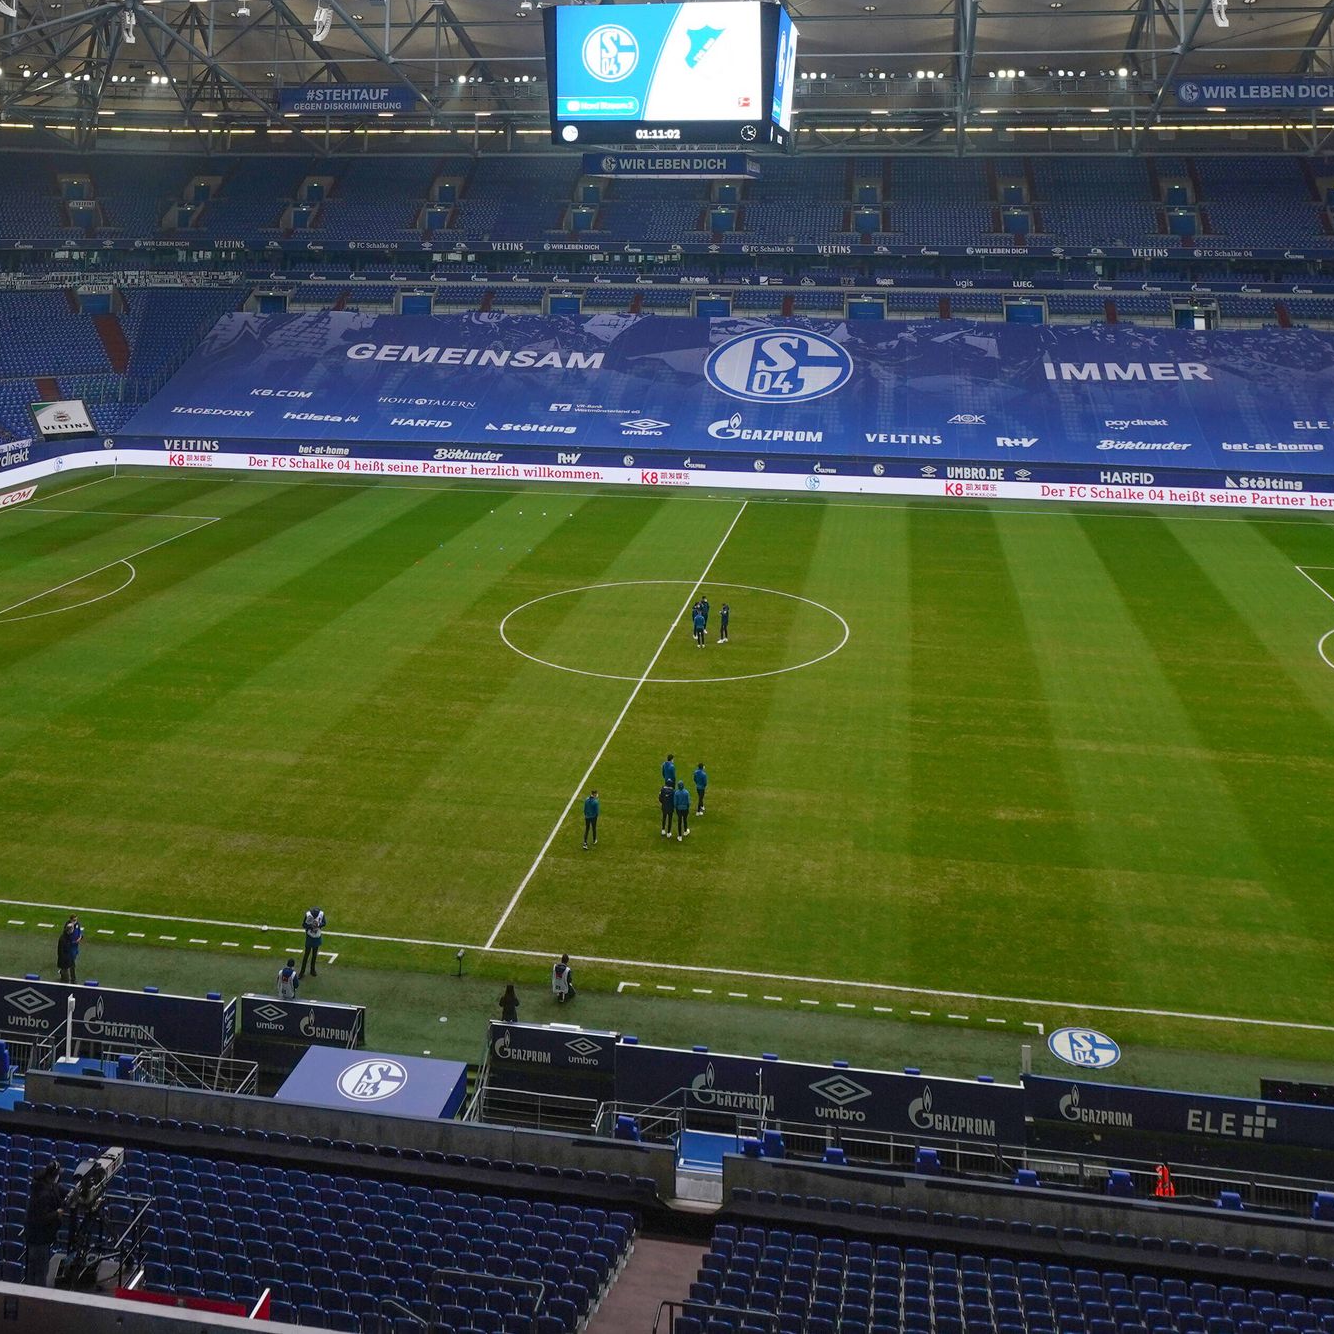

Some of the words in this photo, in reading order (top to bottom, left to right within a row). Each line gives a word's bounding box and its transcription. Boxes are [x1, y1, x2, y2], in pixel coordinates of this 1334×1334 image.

[306, 89, 389, 101] #STEHTAUF
[1203, 86, 1237, 98] WIR
[1239, 85, 1295, 98] LEBEN
[324, 102, 402, 110] DISKRIMINIERUNG
[636, 129, 680, 139] 01:11:02
[619, 159, 647, 170] WIR
[650, 158, 691, 170] LEBEN
[693, 158, 727, 169] DICH
[215, 240, 245, 248] VELTINS
[492, 242, 524, 251] VELTINS
[817, 245, 851, 254] VELTINS
[1132, 248, 1168, 257] VELTINS
[346, 343, 605, 369] GEMEINSAM
[1043, 362, 1214, 380] IMMER
[751, 372, 794, 393] 04
[250, 388, 313, 398] K8.COM
[378, 397, 416, 405] HOHE
[427, 400, 477, 409] TAUERN
[171, 406, 254, 417] HAGEDORN
[43, 422, 89, 431] VELTINS
[390, 417, 452, 428] HARFID
[501, 422, 577, 434] Stölting
[1293, 420, 1330, 430] ELE
[622, 429, 663, 437] umbro
[741, 430, 823, 443] GAZPROM
[866, 433, 942, 445] VELTINS
[164, 439, 219, 451] VELTINS
[996, 437, 1038, 448] R+V
[1096, 439, 1191, 451] Böklunder
[1222, 441, 1324, 452] bet-at-home
[299, 444, 349, 455] bet-at-home
[433, 448, 503, 461] Böklunder
[169, 453, 185, 466] K8
[557, 453, 581, 464] R+V
[249, 456, 268, 467] Der
[272, 457, 286, 468] FC
[289, 457, 334, 470] Schalke
[337, 460, 350, 470] 04
[354, 459, 384, 472] heißt
[387, 462, 418, 473] seine
[422, 462, 467, 475] Partner
[470, 464, 519, 477] herzlich
[523, 467, 604, 480] willkommen.
[946, 466, 1004, 480] UMBRO.DE
[641, 469, 658, 484] K8
[1100, 471, 1154, 484] HARFID
[945, 481, 963, 496] K8
[1238, 477, 1303, 490] Stölting
[1041, 485, 1065, 497] Der
[1069, 486, 1086, 498] FC
[1091, 487, 1143, 500] Schalke
[1149, 489, 1164, 501] 04
[1169, 490, 1206, 502] heißt
[1209, 492, 1247, 504] seine
[1252, 493, 1305, 506] Partner
[8, 1016, 49, 1030] umbro
[256, 1021, 284, 1031] umbro
[512, 1048, 551, 1064] GAZPROM
[568, 1056, 598, 1066] umbro
[815, 1106, 865, 1122] umbro
[1081, 1110, 1133, 1127] GAZPROM
[934, 1115, 995, 1136] GAZPROM
[1187, 1109, 1236, 1135] ELE
